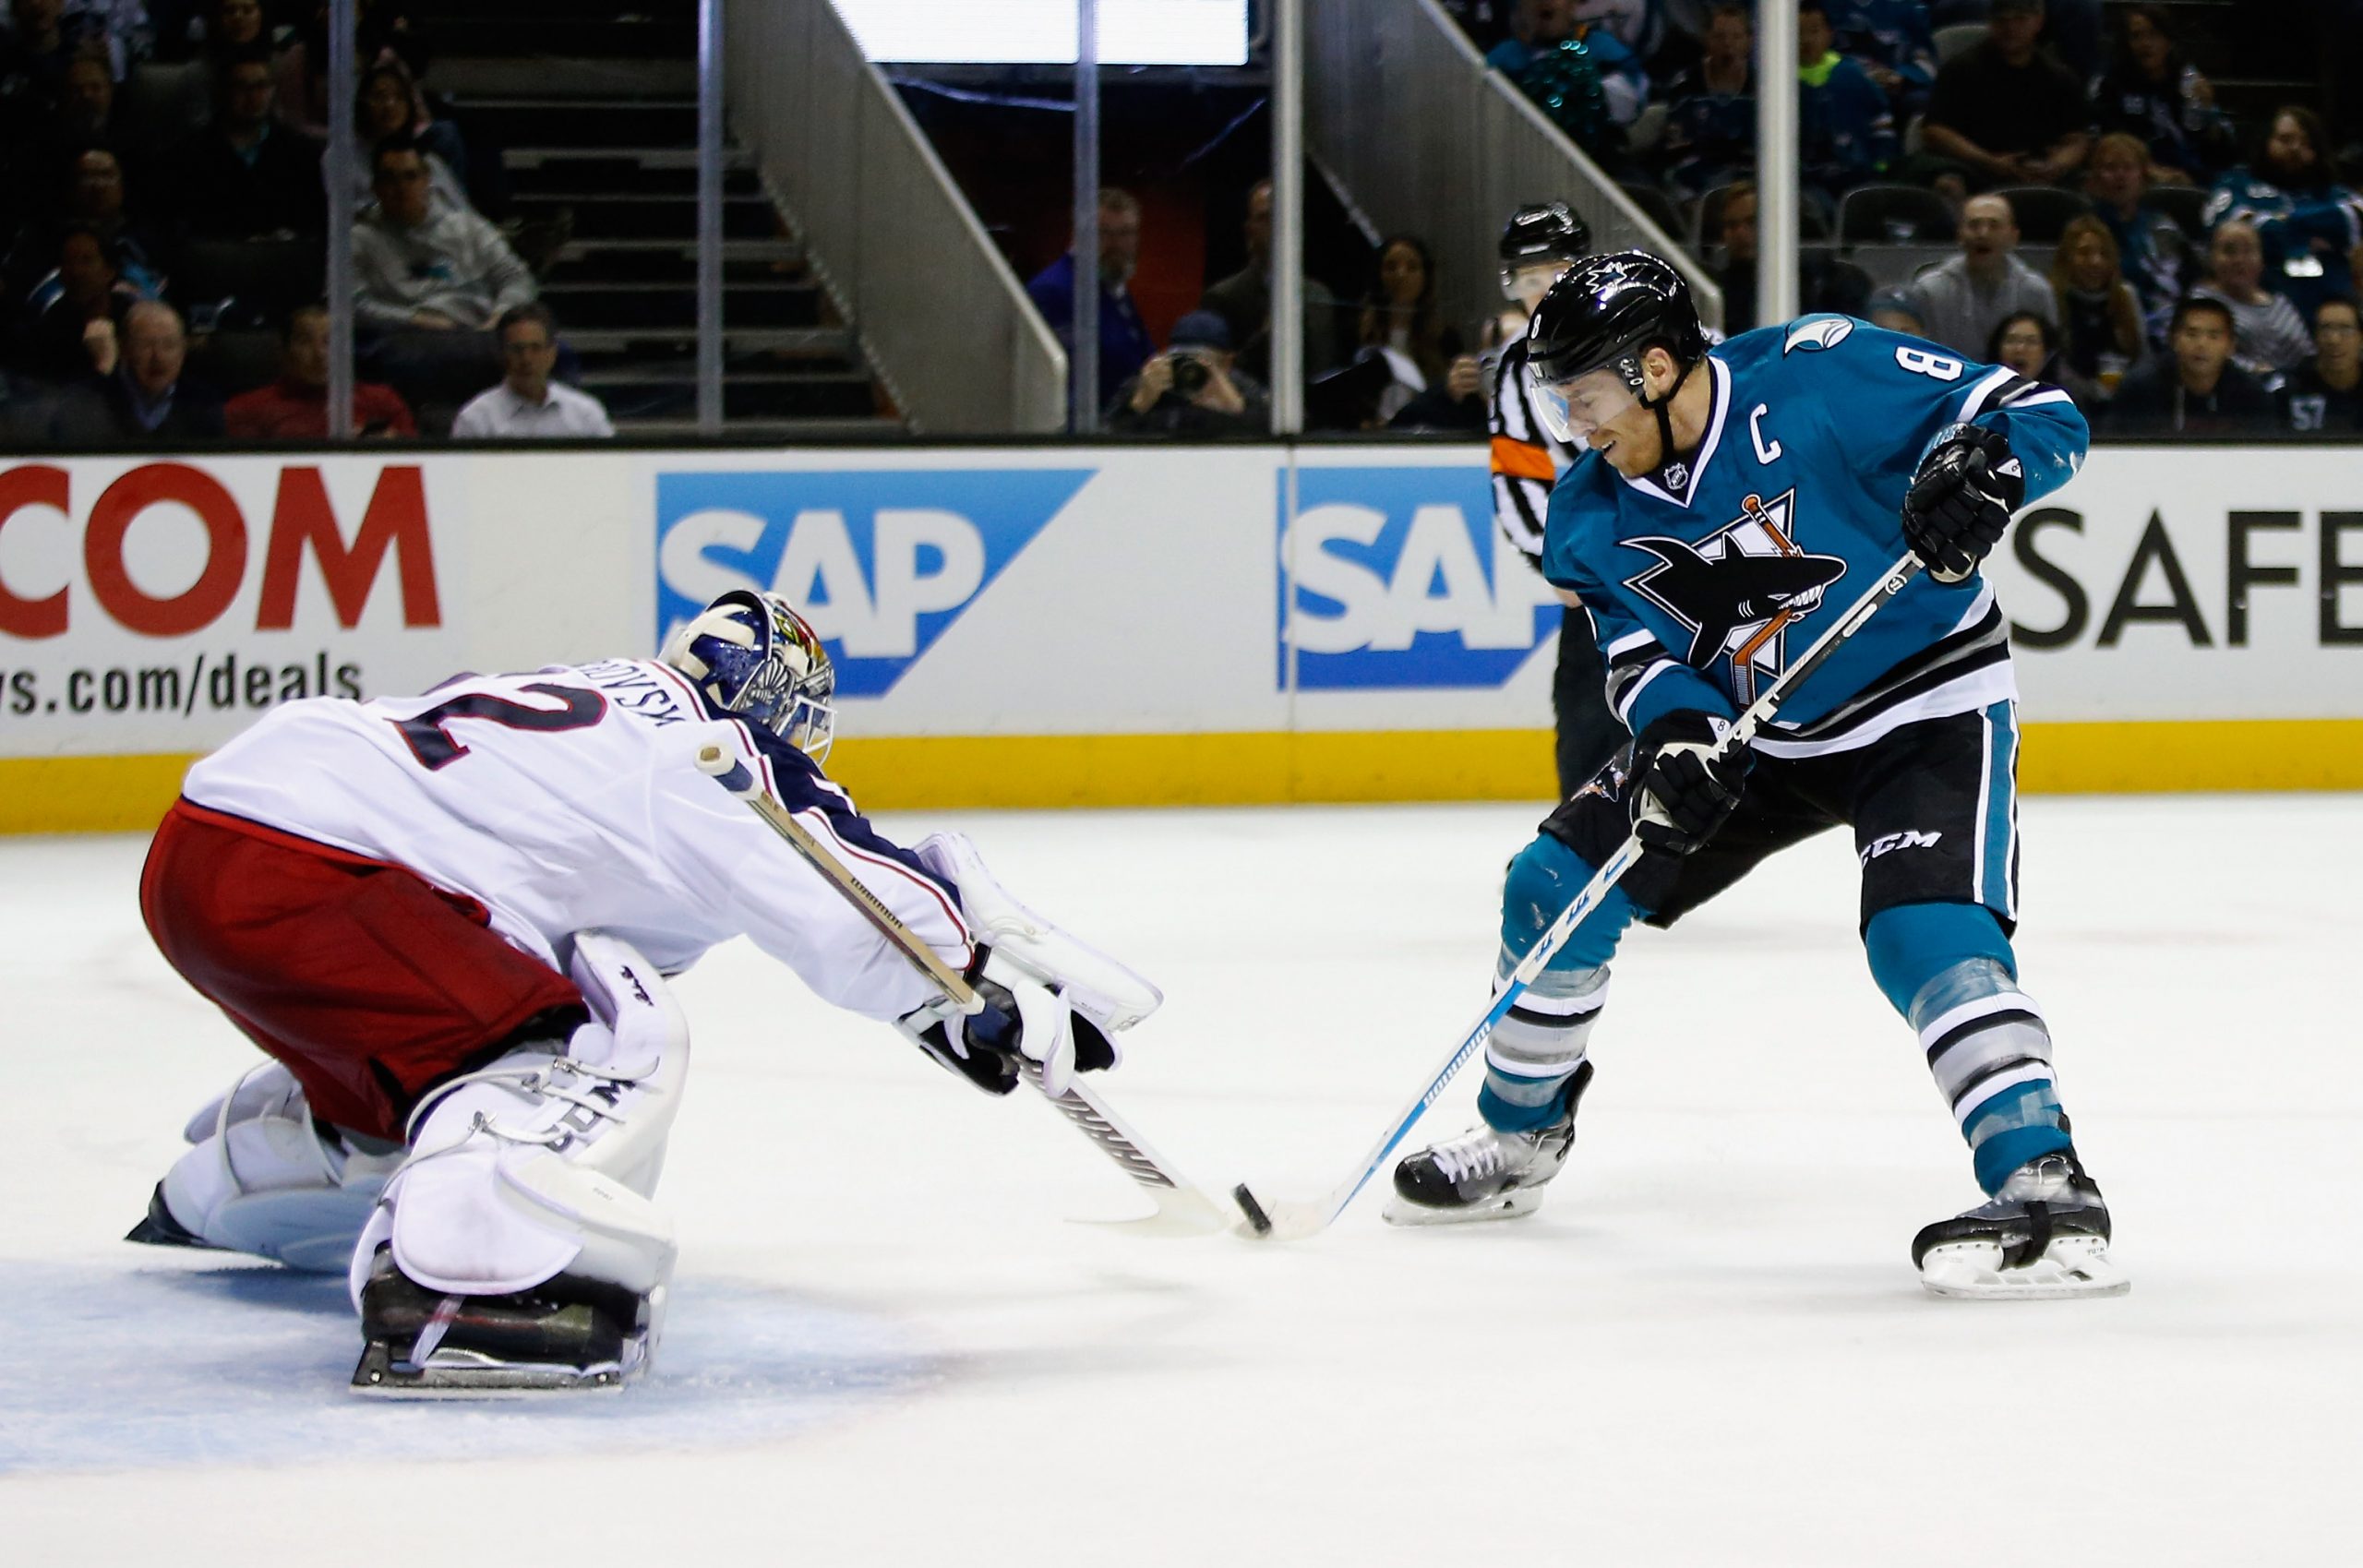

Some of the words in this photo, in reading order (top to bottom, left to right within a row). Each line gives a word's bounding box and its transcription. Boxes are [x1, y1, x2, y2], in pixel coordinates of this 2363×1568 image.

[1530, 314, 1541, 340] 8
[1895, 345, 1963, 381] 8
[1750, 402, 1782, 464] C
[0, 461, 441, 640] COM
[660, 508, 986, 658] SAP
[2004, 507, 2363, 650] SAFE
[0, 651, 363, 718] s.com/deals
